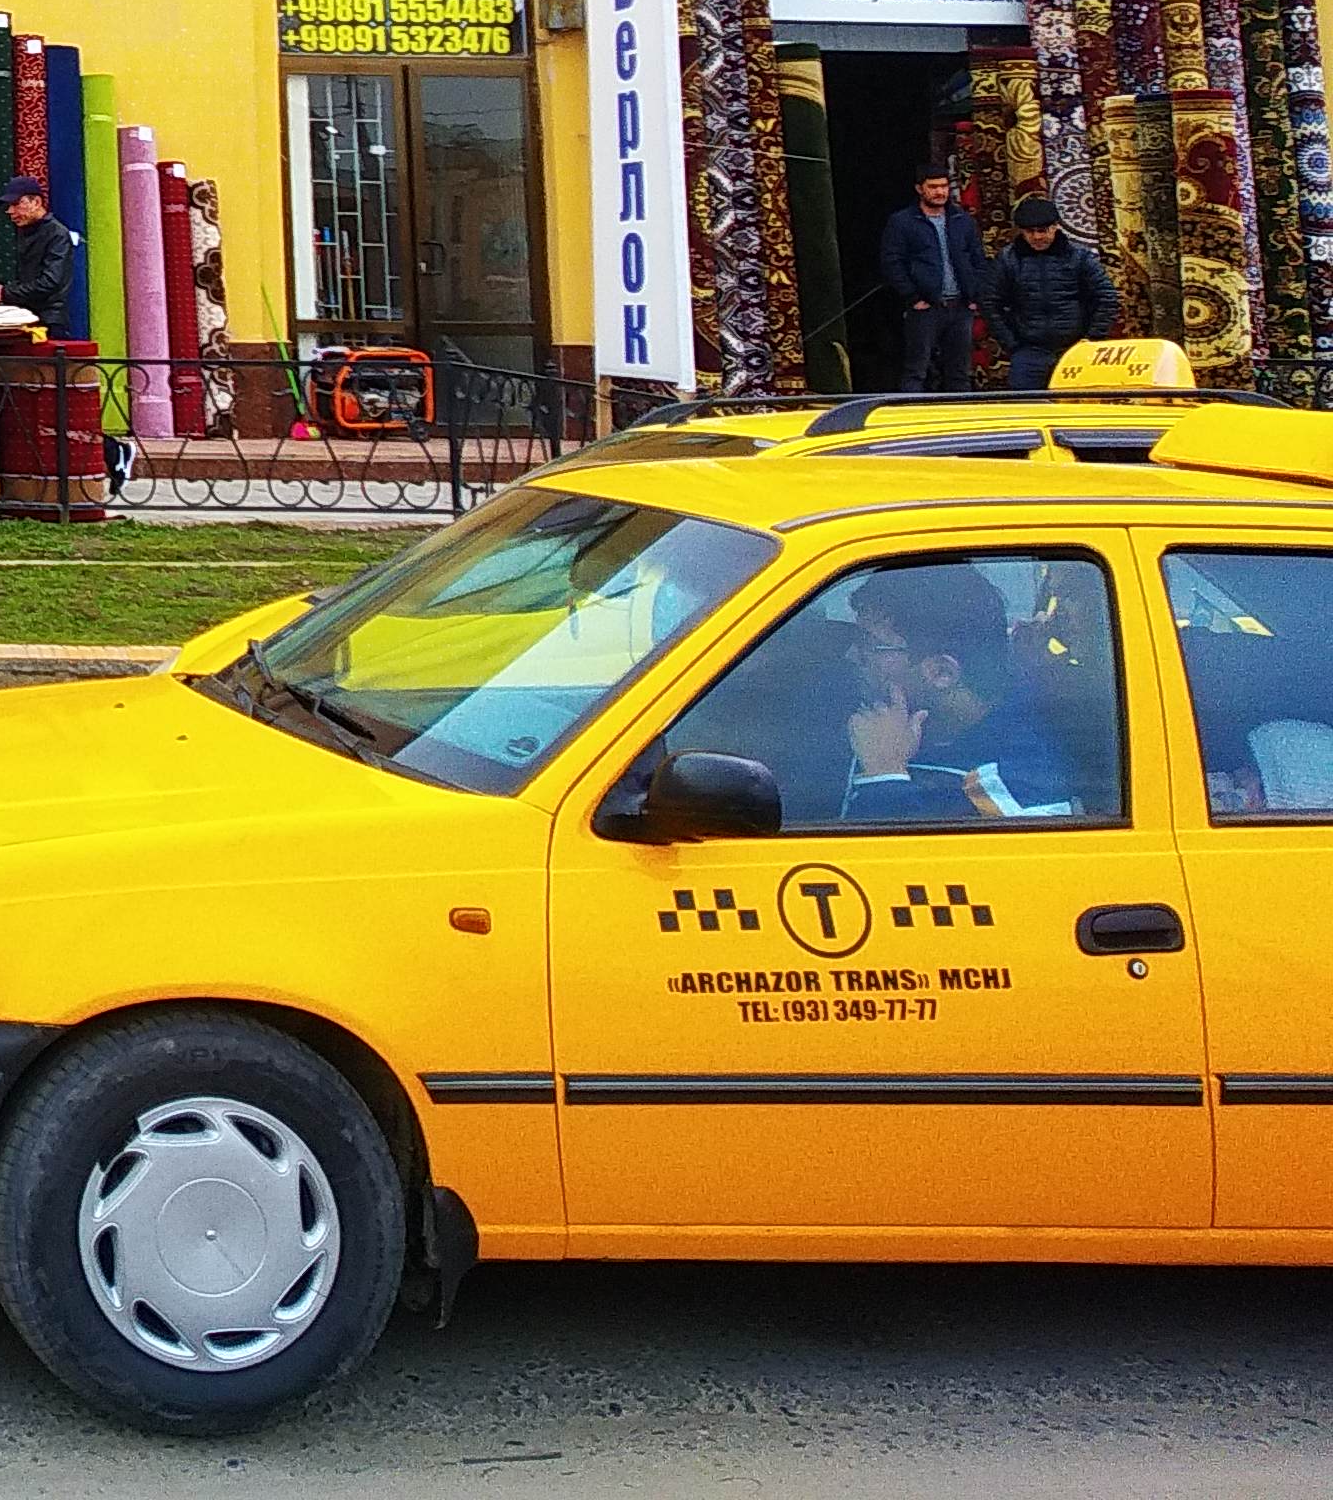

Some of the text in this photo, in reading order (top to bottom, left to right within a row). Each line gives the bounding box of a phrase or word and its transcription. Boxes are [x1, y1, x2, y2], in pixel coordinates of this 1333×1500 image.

[1091, 346, 1137, 366] TAXI
[799, 882, 841, 939] T
[668, 967, 1012, 994] «ARCHAZOR TRANS» MCHJ
[834, 998, 937, 1022] 349-77-77
